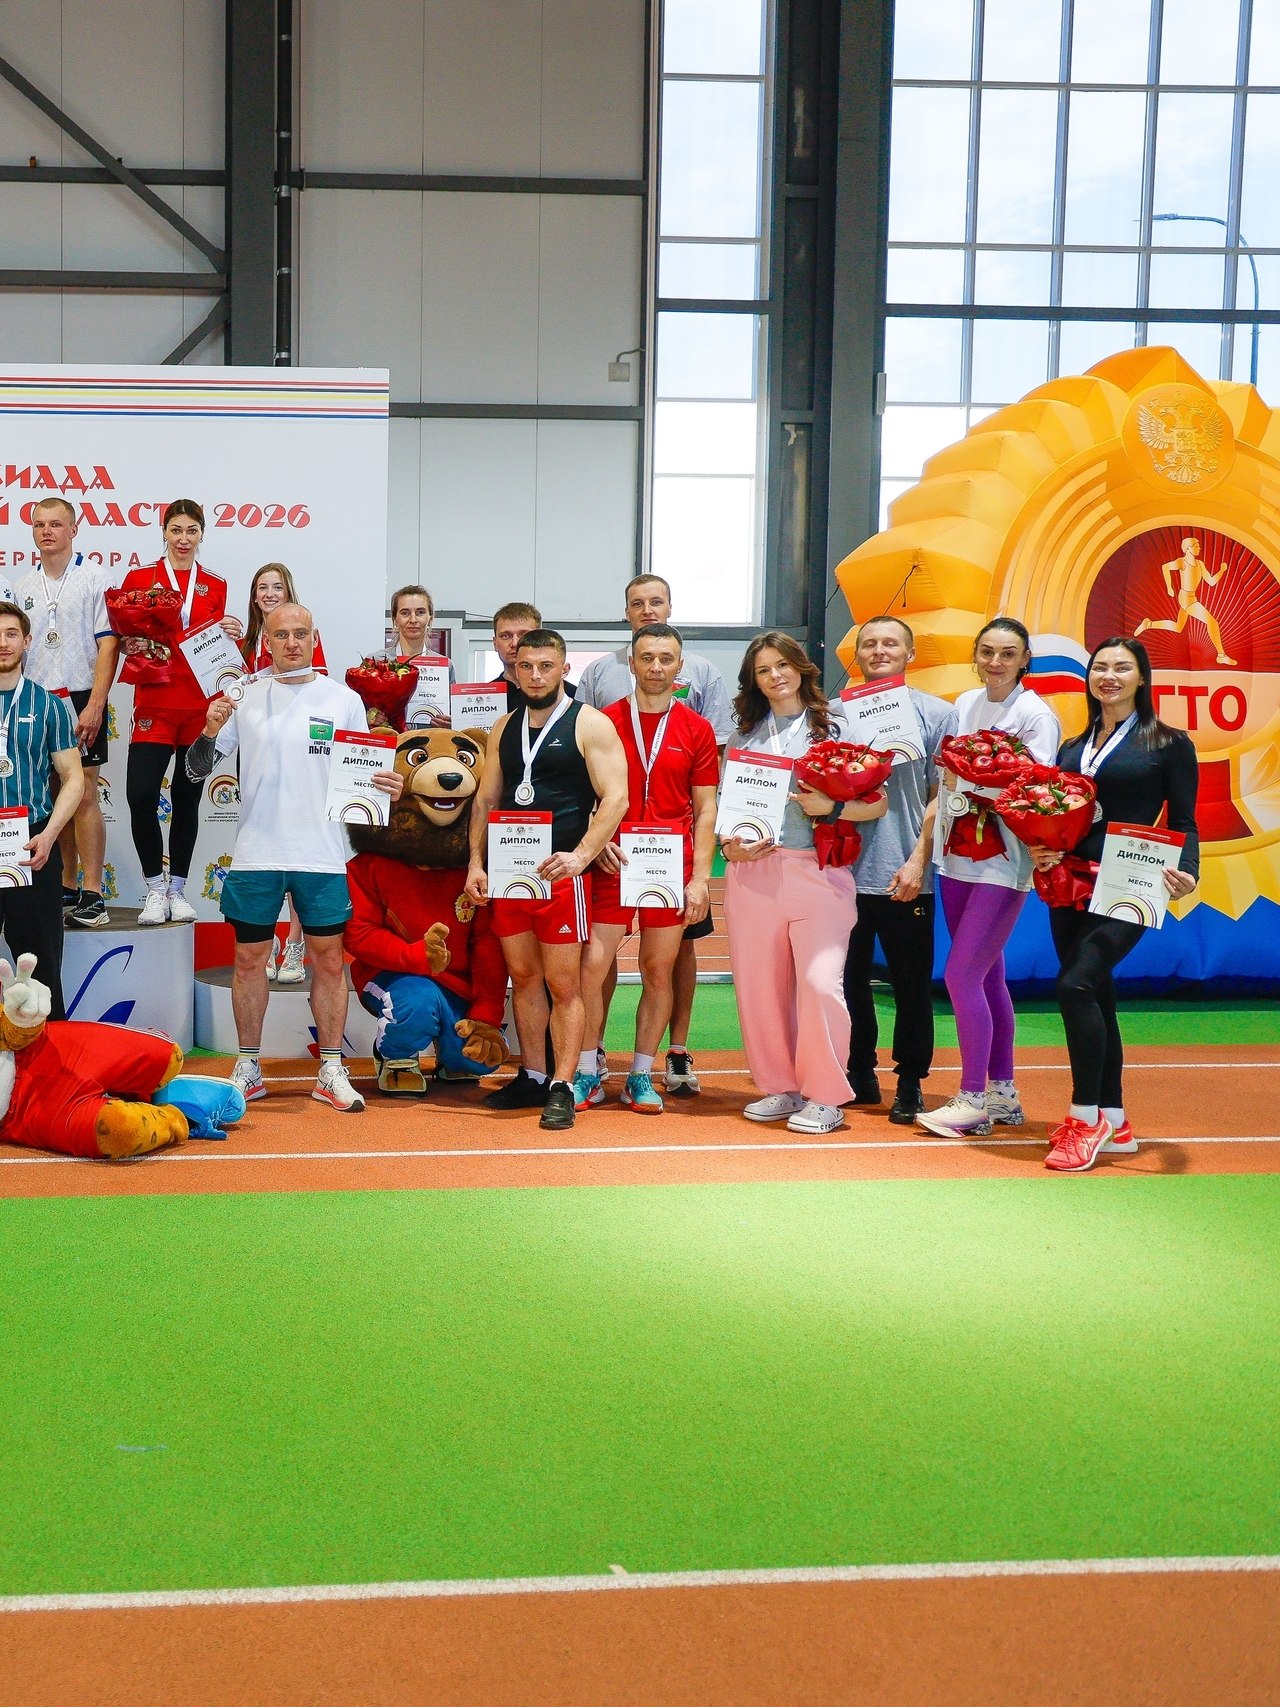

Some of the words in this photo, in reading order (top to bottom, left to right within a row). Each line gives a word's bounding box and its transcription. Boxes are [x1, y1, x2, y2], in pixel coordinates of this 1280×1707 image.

[213, 503, 311, 529] 2026
[193, 633, 223, 655] ДИПЛОМ
[210, 652, 227, 664] МЕСТО
[461, 705, 497, 713] ДИПЛОМ
[859, 702, 900, 719] ДИПЛОМ
[879, 725, 901, 734] МЕСТО
[342, 756, 383, 768] ДИПЛОМ
[736, 776, 777, 788] ДИПЛОМ
[746, 800, 768, 809] МЕСТО
[500, 837, 540, 845] ДИПЛОМ
[632, 846, 672, 855] ДИПЛОМ
[1116, 850, 1166, 867] ДИПЛОМ
[1128, 878, 1153, 888] МЕСТО
